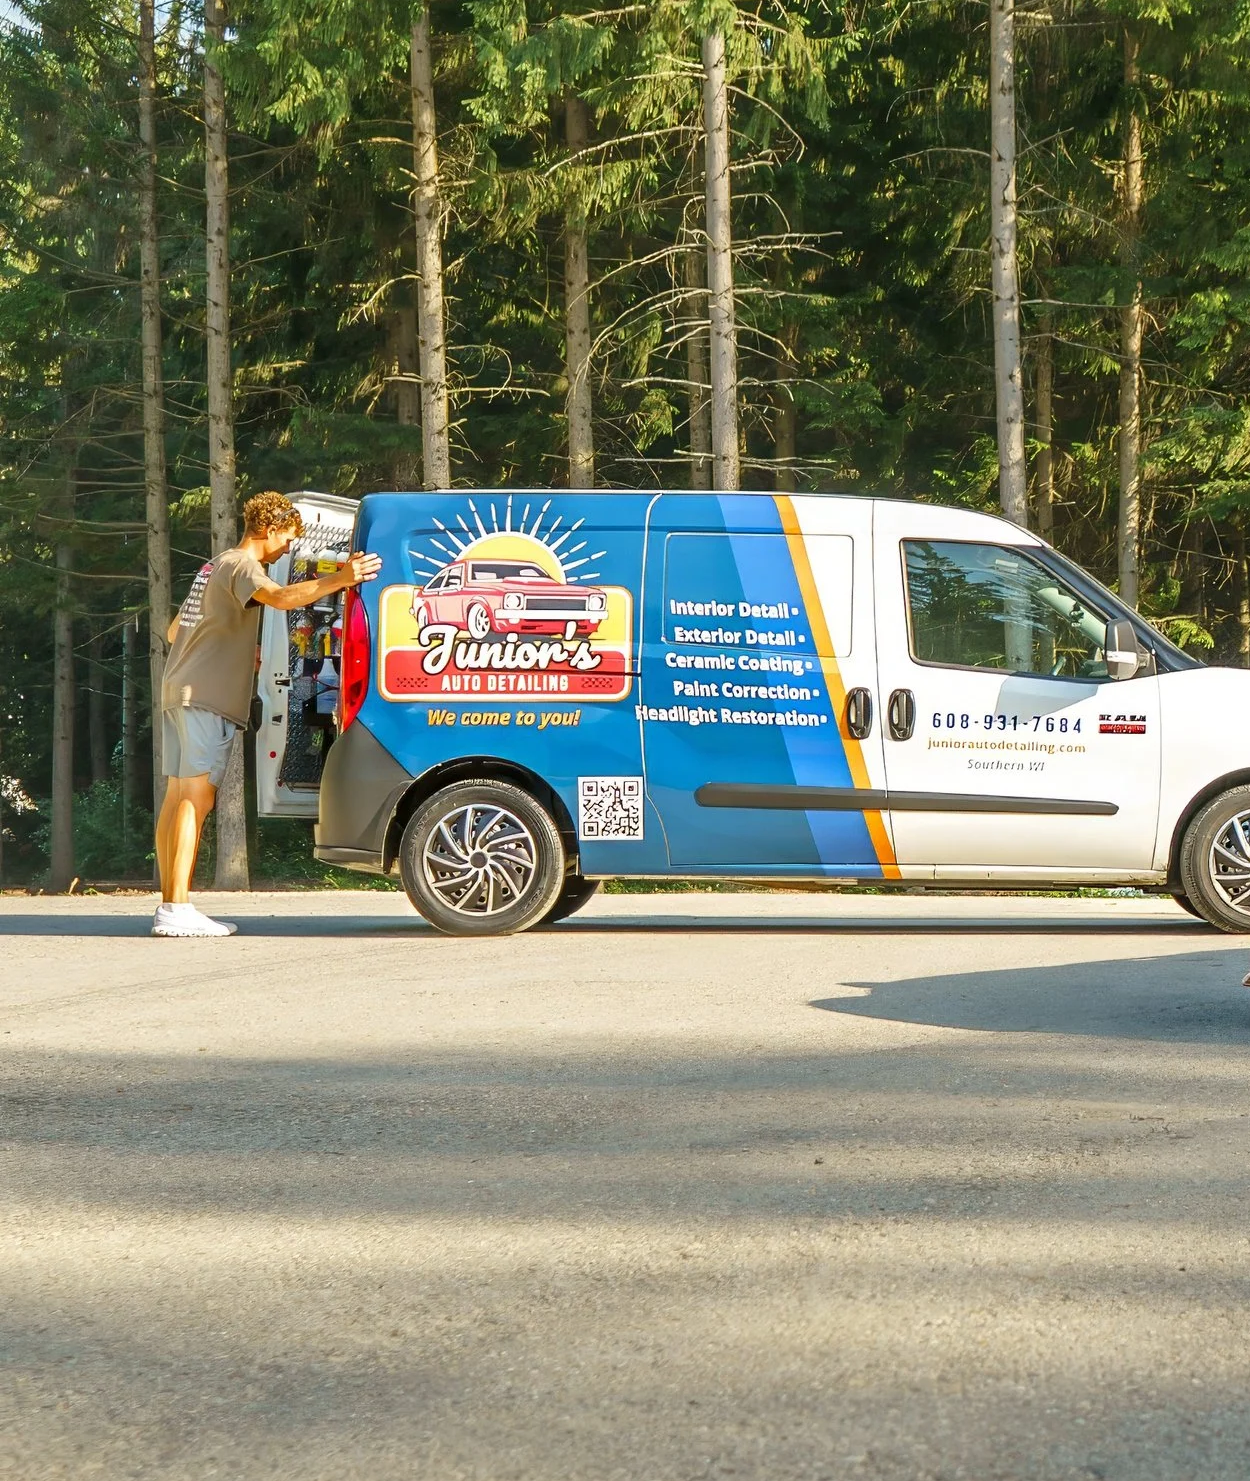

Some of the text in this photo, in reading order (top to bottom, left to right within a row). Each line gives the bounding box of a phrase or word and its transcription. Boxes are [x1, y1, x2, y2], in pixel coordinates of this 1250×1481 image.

[670, 599, 790, 619] Interior Detail
[674, 626, 796, 646] Exterior Detail
[418, 620, 602, 675] Junior's
[665, 652, 804, 676] Ceramic Coating
[441, 674, 569, 692] AUTO DETAILING
[673, 680, 812, 700] Paint Correction
[427, 709, 582, 730] We come to you!
[635, 705, 821, 727] Headlight Restoration
[932, 712, 1082, 734] 608-931-7684
[927, 737, 1086, 755] juniorautodetailing.com
[967, 759, 1024, 771] Southern
